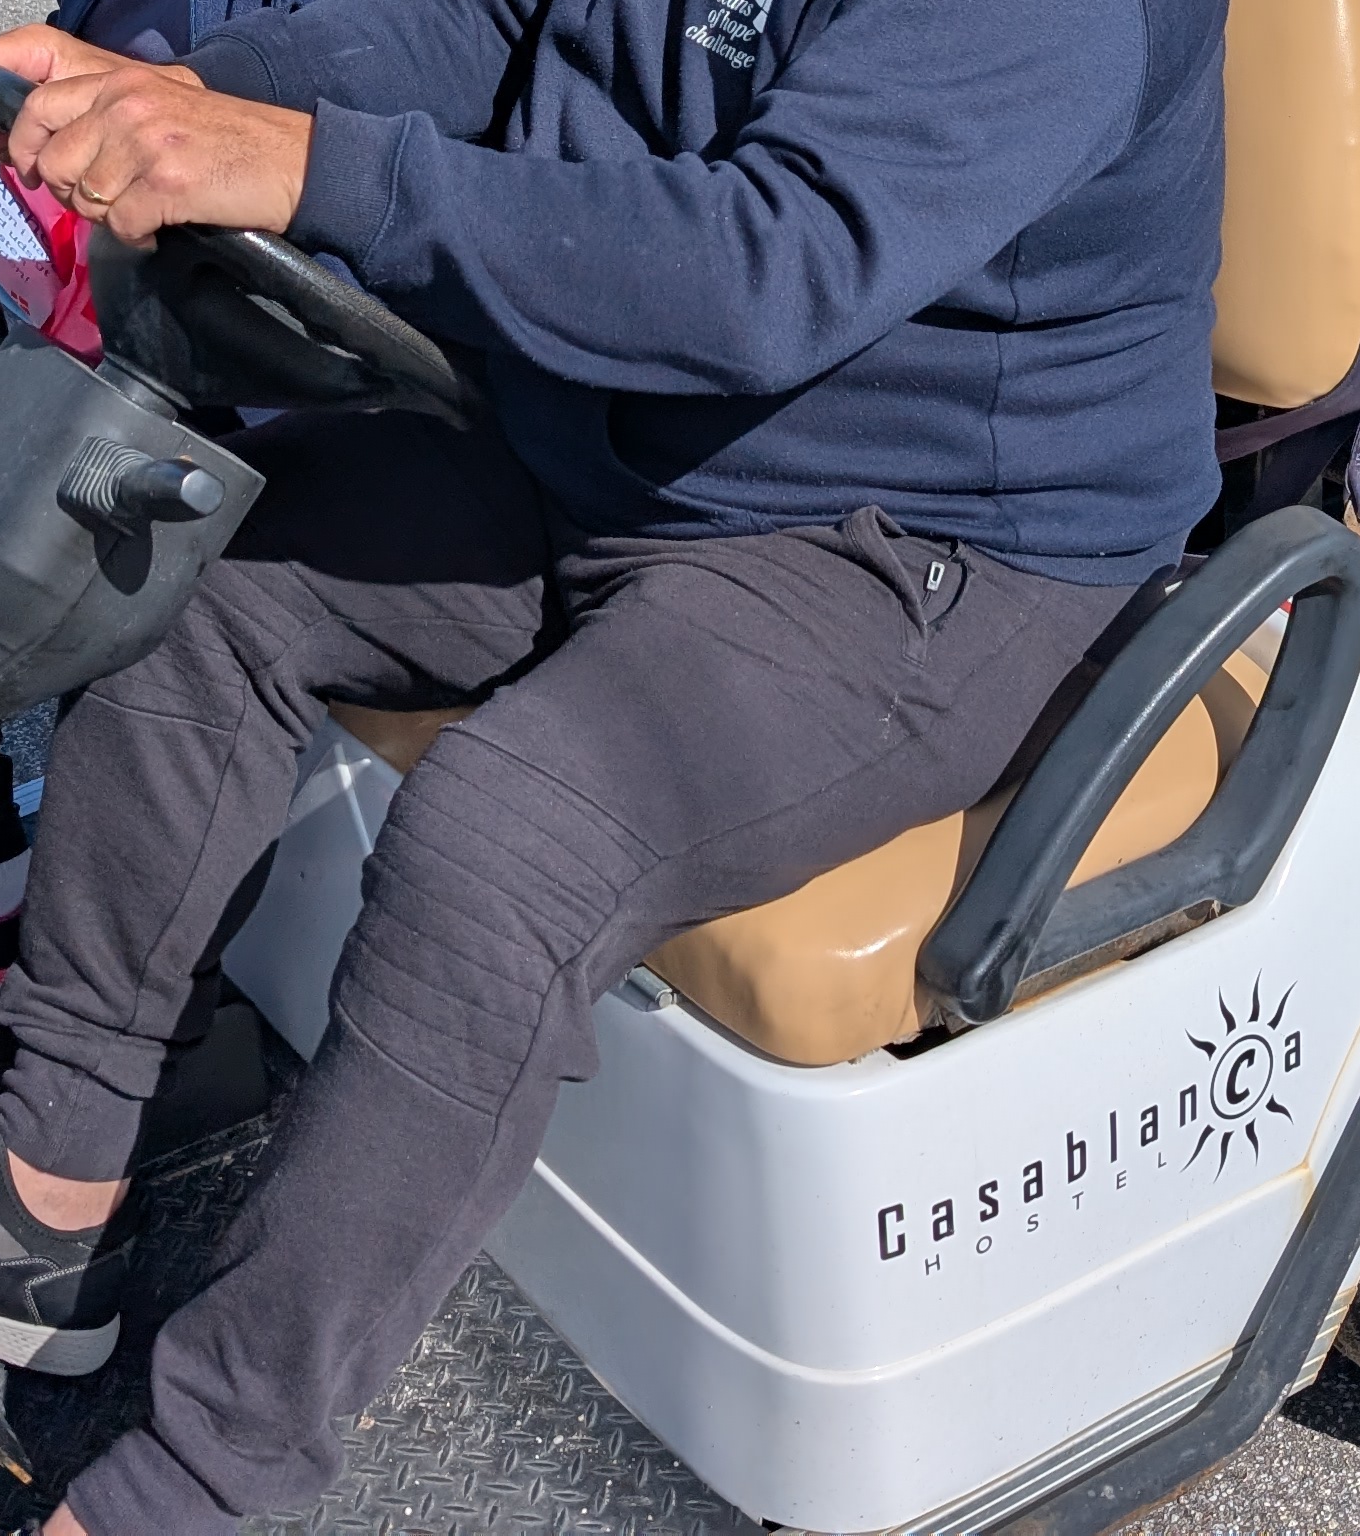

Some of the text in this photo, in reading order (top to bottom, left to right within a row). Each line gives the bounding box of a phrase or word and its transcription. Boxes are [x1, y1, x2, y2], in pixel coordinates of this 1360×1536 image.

[685, 24, 756, 69] challenge
[707, 9, 756, 41] of hope
[924, 1151, 1167, 1276] HOSTEL
